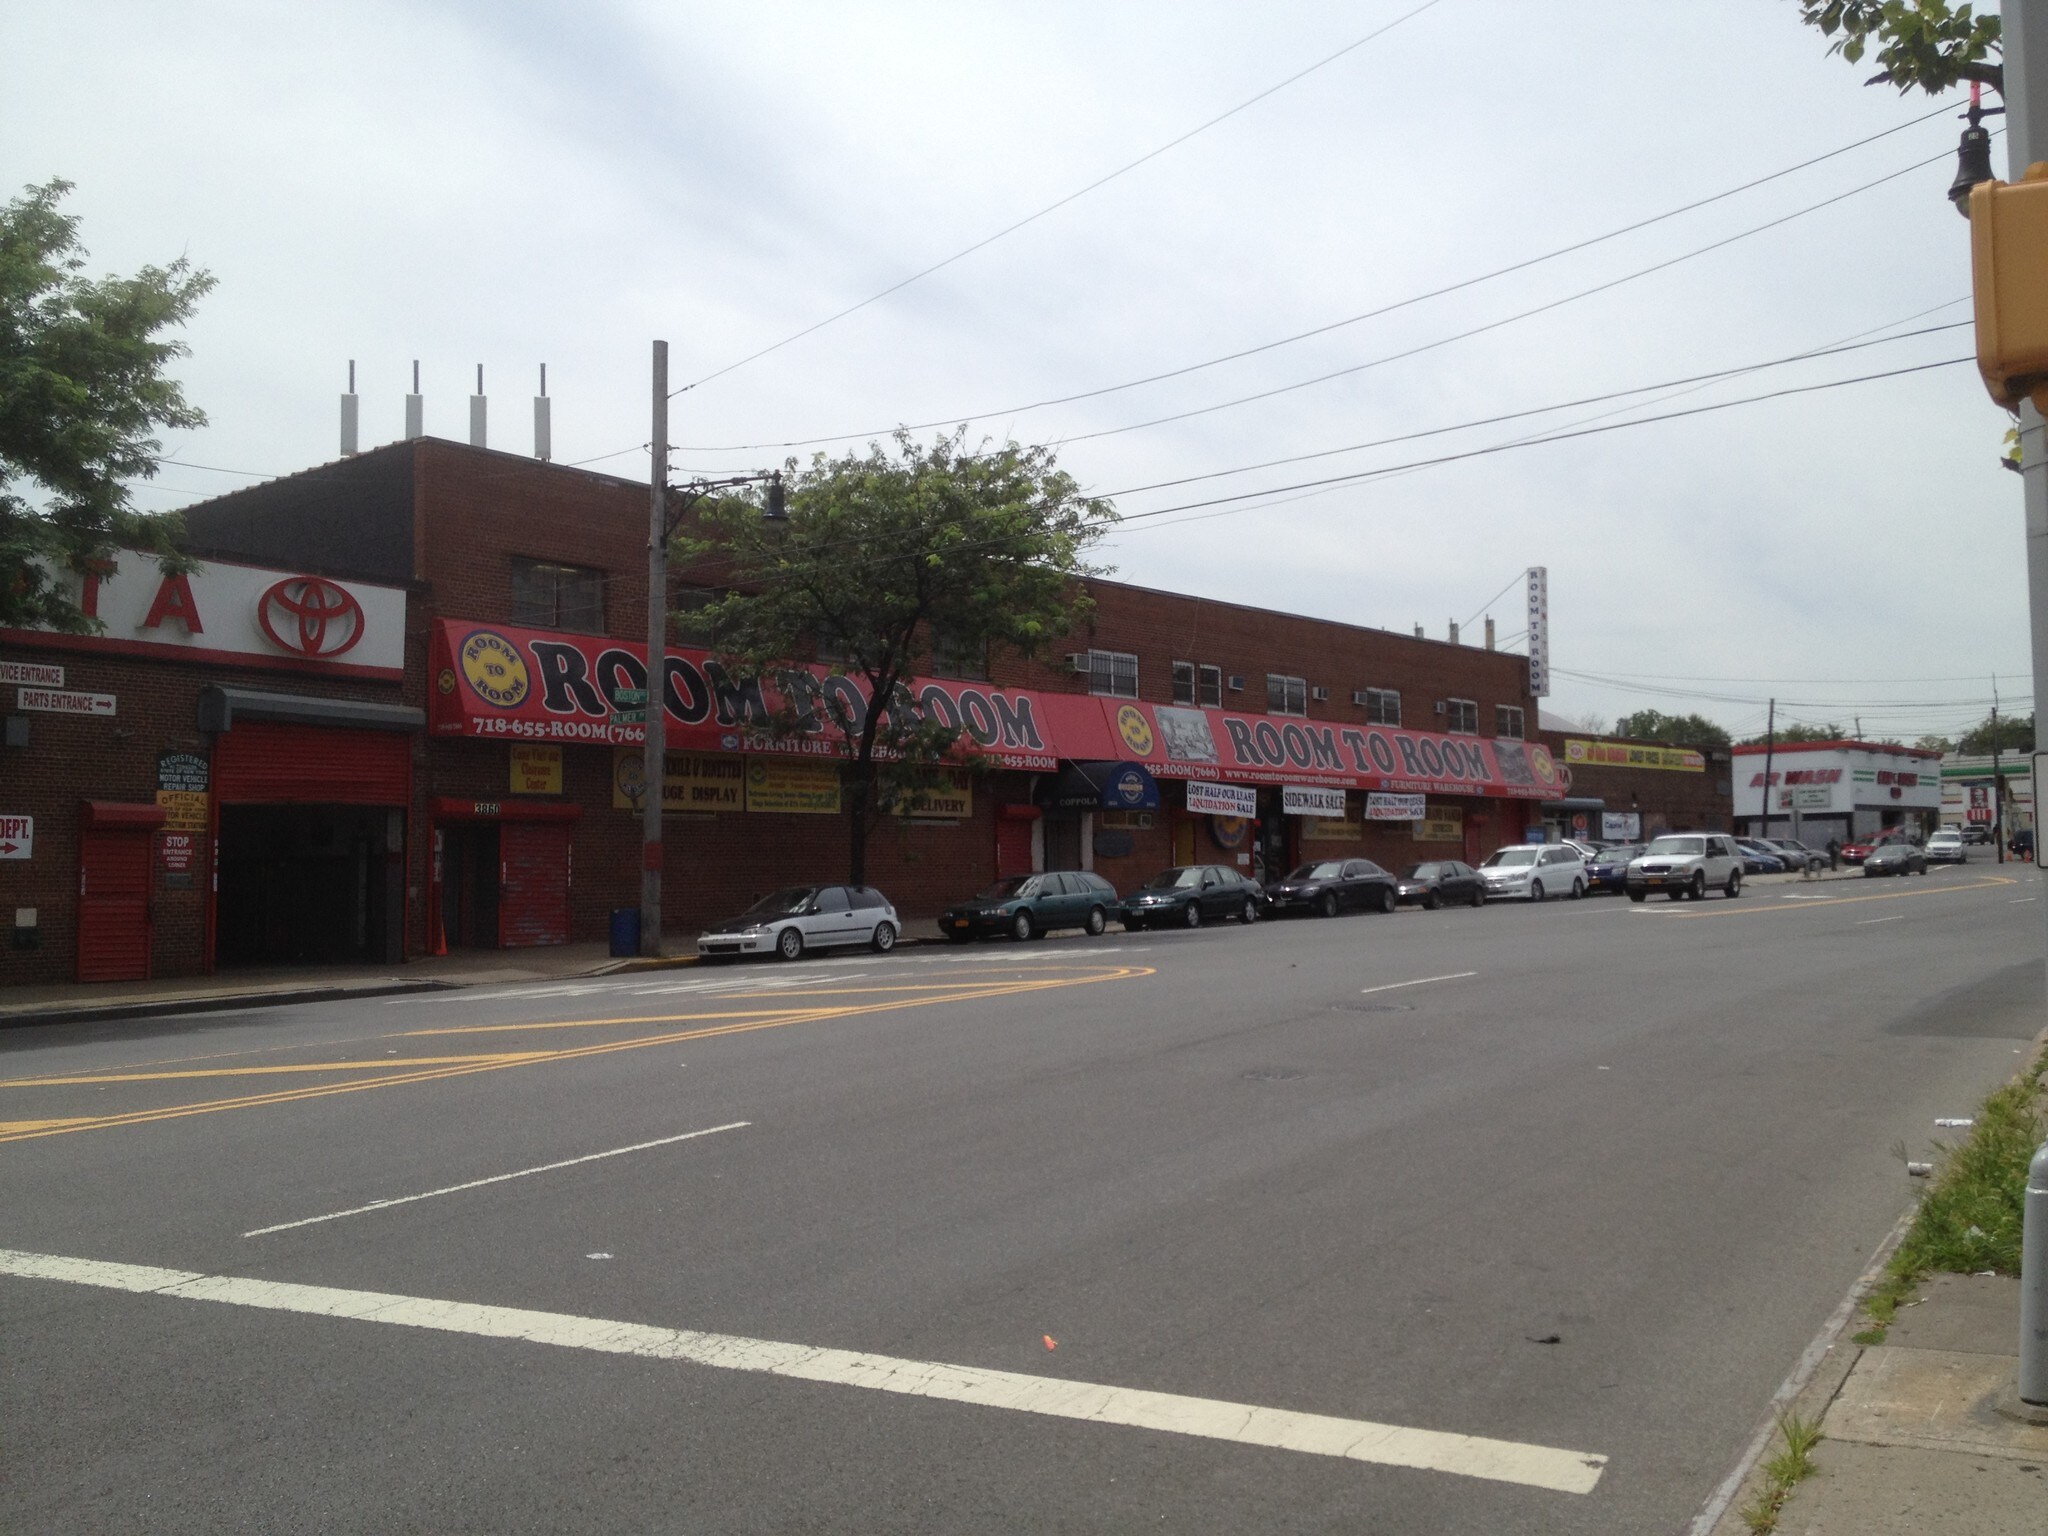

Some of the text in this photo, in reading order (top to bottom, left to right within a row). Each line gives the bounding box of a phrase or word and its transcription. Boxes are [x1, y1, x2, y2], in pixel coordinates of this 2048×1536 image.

[1530, 571, 1541, 692] ROOM TO ROOM
[466, 638, 517, 664] ROOM
[21, 666, 61, 684] ENTRANCE
[484, 663, 506, 677] TO
[475, 677, 524, 703] ROOM
[529, 640, 769, 728] ROOM
[23, 691, 93, 711] PARTS ENTRANCE
[615, 690, 640, 701] BOSTON
[610, 712, 637, 724] PALMER
[473, 717, 646, 743] 718-655-ROOM(766
[743, 734, 832, 755] FURNITURE
[1223, 717, 1345, 772] ROOM
[1341, 729, 1396, 775] TO
[1394, 734, 1492, 782] ROOM
[160, 754, 208, 770] REGISTERED
[159, 773, 208, 784] MOTOR VEHICLE
[1785, 769, 1842, 785] WASH
[163, 782, 205, 791] REPAIR SHOP
[663, 785, 685, 801] UGE
[692, 785, 738, 803] DISPLAY
[1188, 784, 1255, 802] LOST HALF OUR LEASE
[1391, 779, 1433, 791] FURNITURE
[1434, 782, 1476, 793] WAREHOUSE
[161, 793, 206, 806] OFFICIAL
[1059, 797, 1098, 807] COPPOLA
[1188, 797, 1254, 814] LIQUIDATION SALE
[1284, 791, 1345, 810] SIDEWALK SALE
[166, 836, 189, 848] STOP
[162, 848, 192, 856] ENTRANCE
